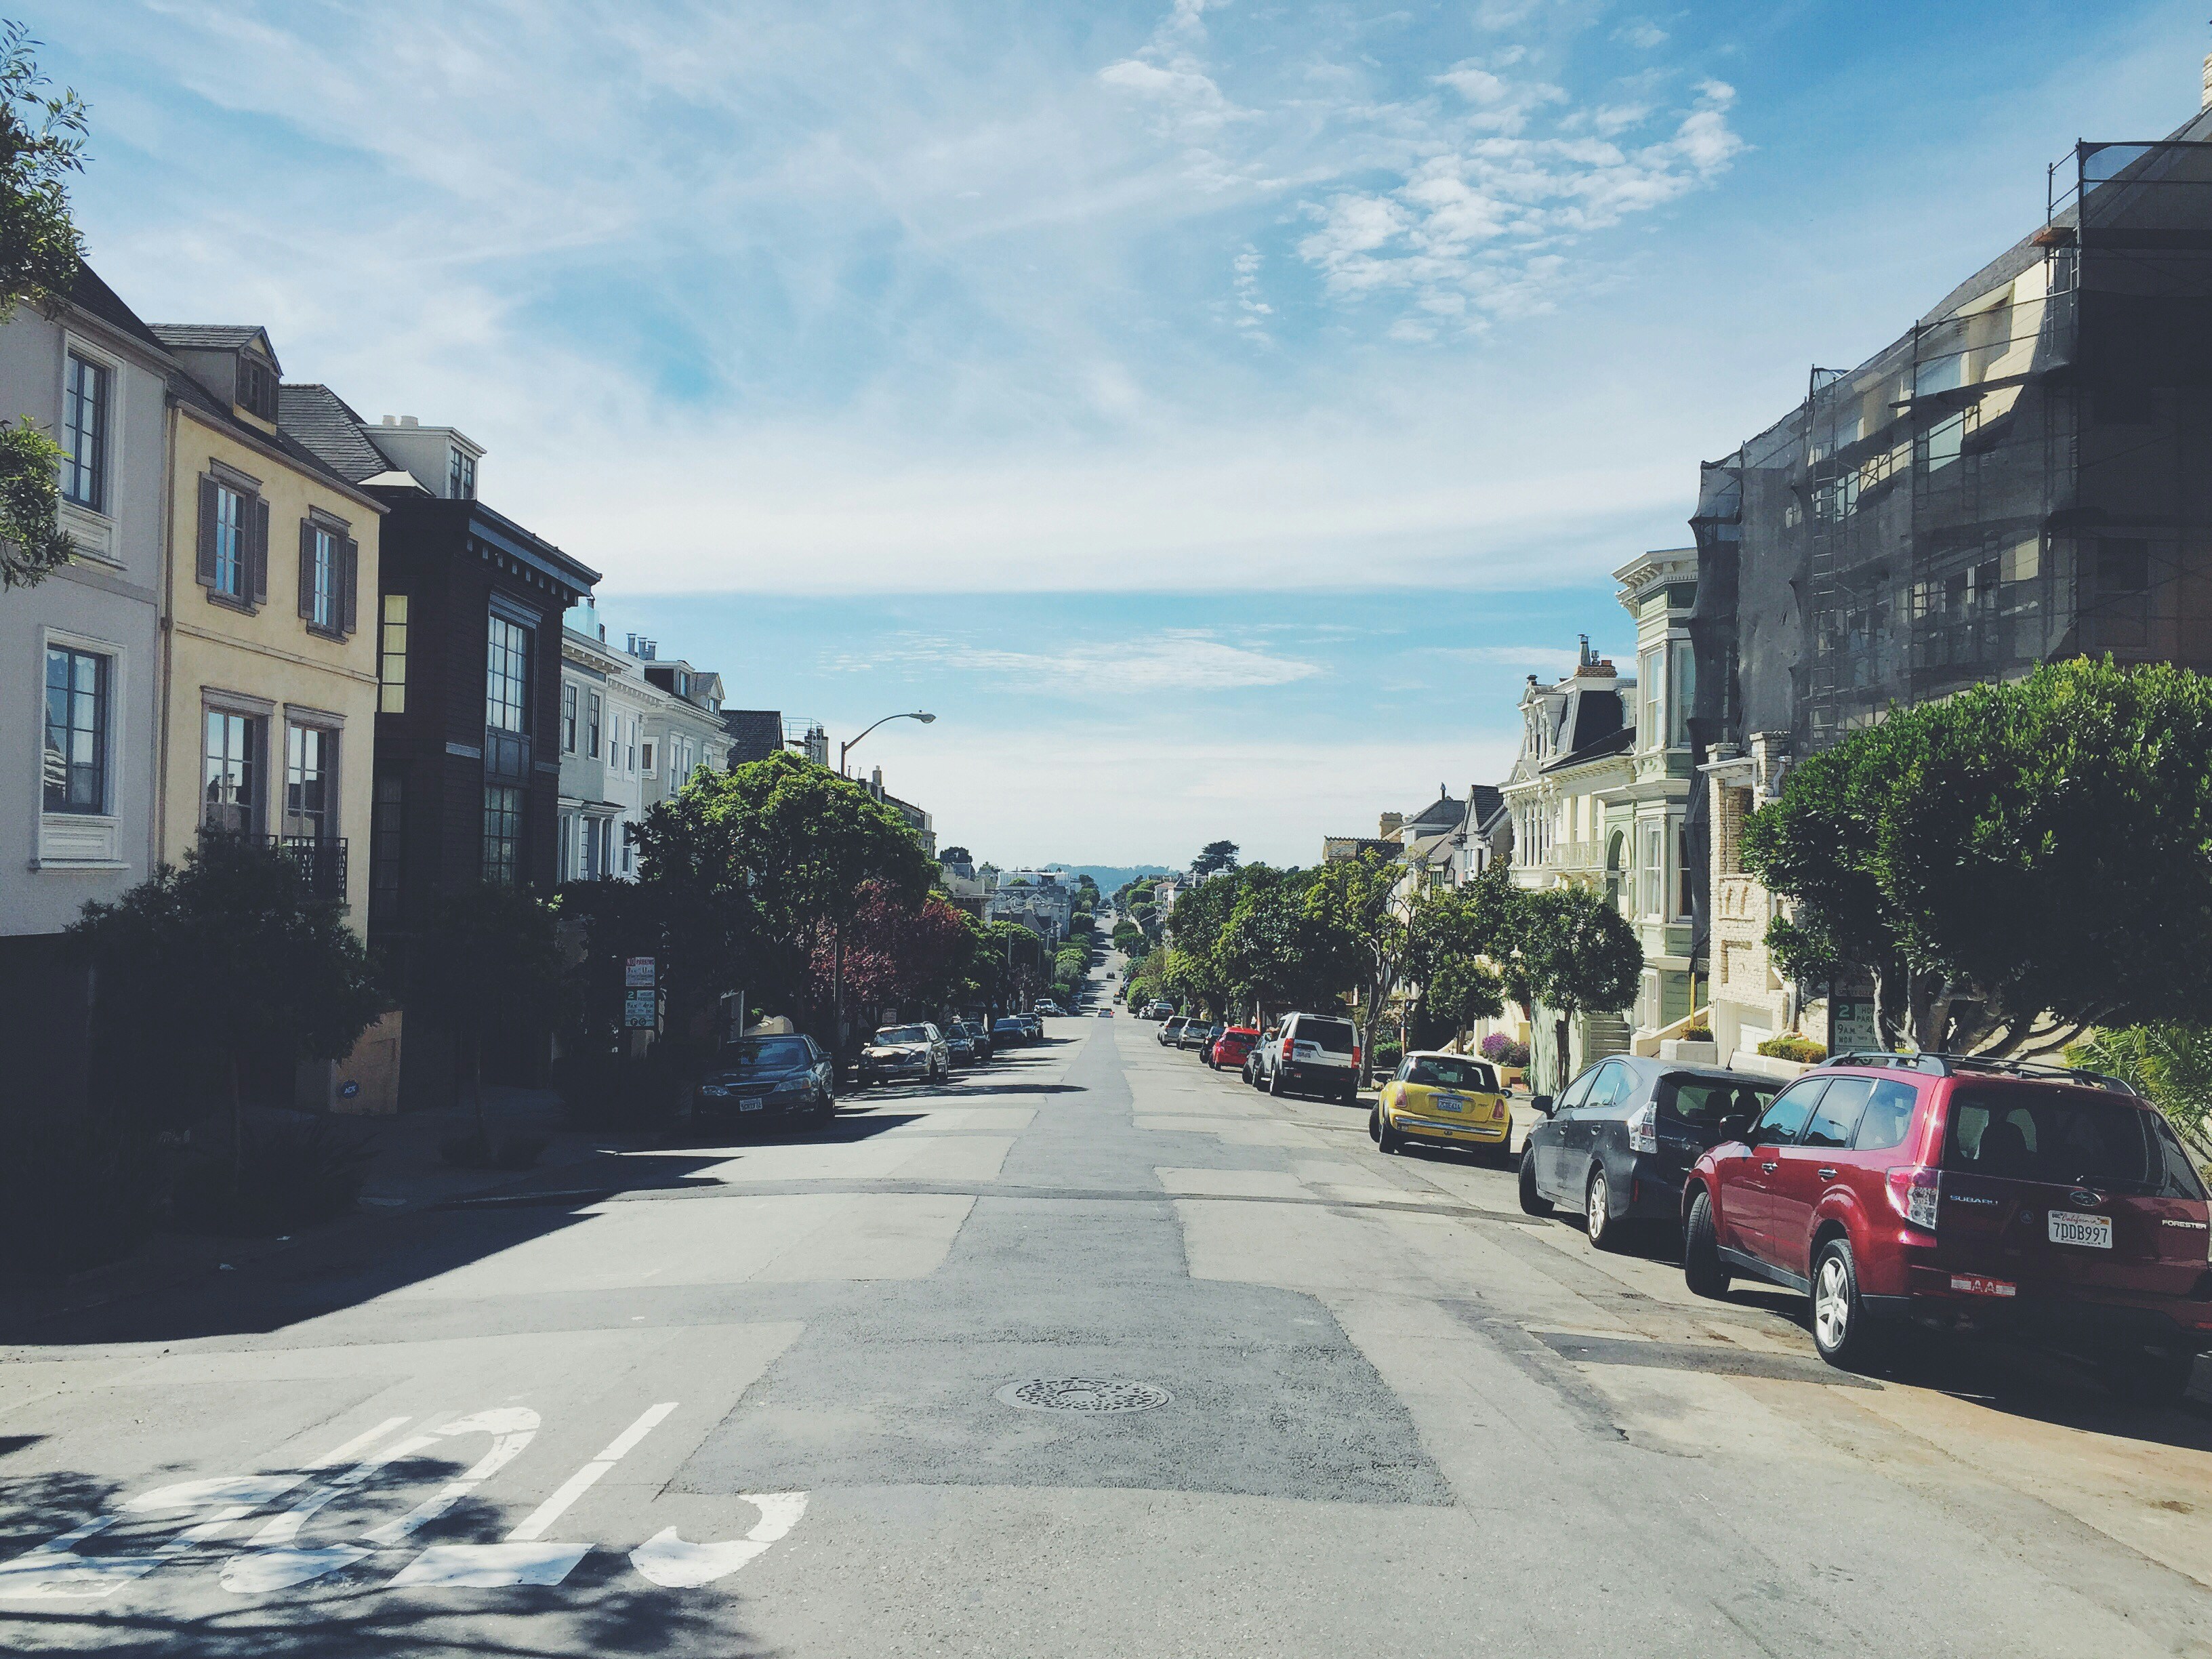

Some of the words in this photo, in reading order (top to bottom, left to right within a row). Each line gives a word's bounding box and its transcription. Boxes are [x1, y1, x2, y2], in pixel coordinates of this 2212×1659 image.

[627, 958, 635, 966] NO
[628, 991, 634, 999] 2
[1839, 1004, 1849, 1017] 2
[2162, 1219, 2207, 1229] FORESTER
[2053, 1222, 2108, 1244] 7DDB997
